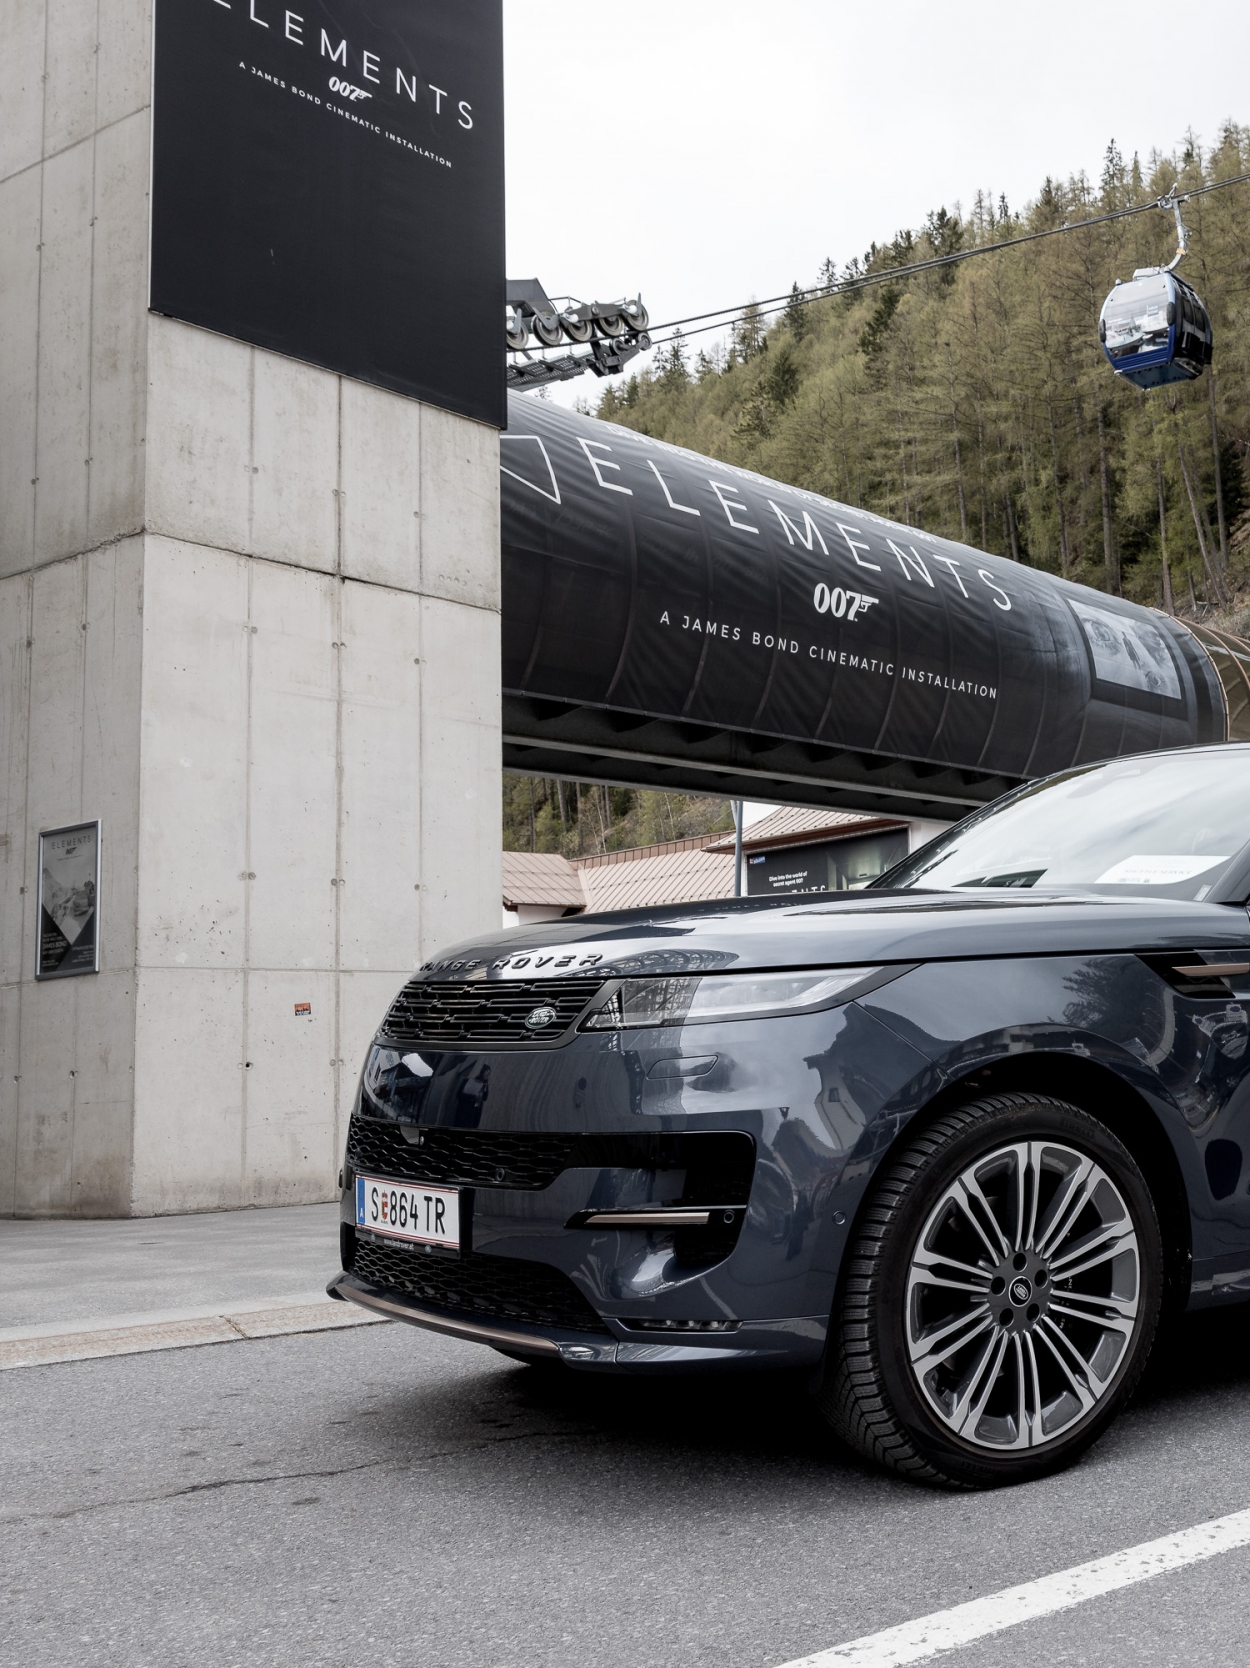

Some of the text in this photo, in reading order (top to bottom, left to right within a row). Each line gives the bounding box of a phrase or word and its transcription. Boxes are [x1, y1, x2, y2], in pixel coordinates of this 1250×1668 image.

[213, 0, 474, 130] LEMENTS
[329, 76, 373, 102] 007
[239, 61, 452, 168] A JAMES BOND CINEMATIC INSTALLATION
[576, 436, 1012, 611] ELEMENTS
[813, 582, 879, 622] 007
[660, 610, 997, 700] A JAMES BOND CINEMATIC INSTALLATION
[51, 835, 91, 850] ELEMENTS
[420, 953, 604, 973] RANGE ROVER
[360, 1207, 364, 1218] A
[371, 1186, 445, 1234] S 864 TR
